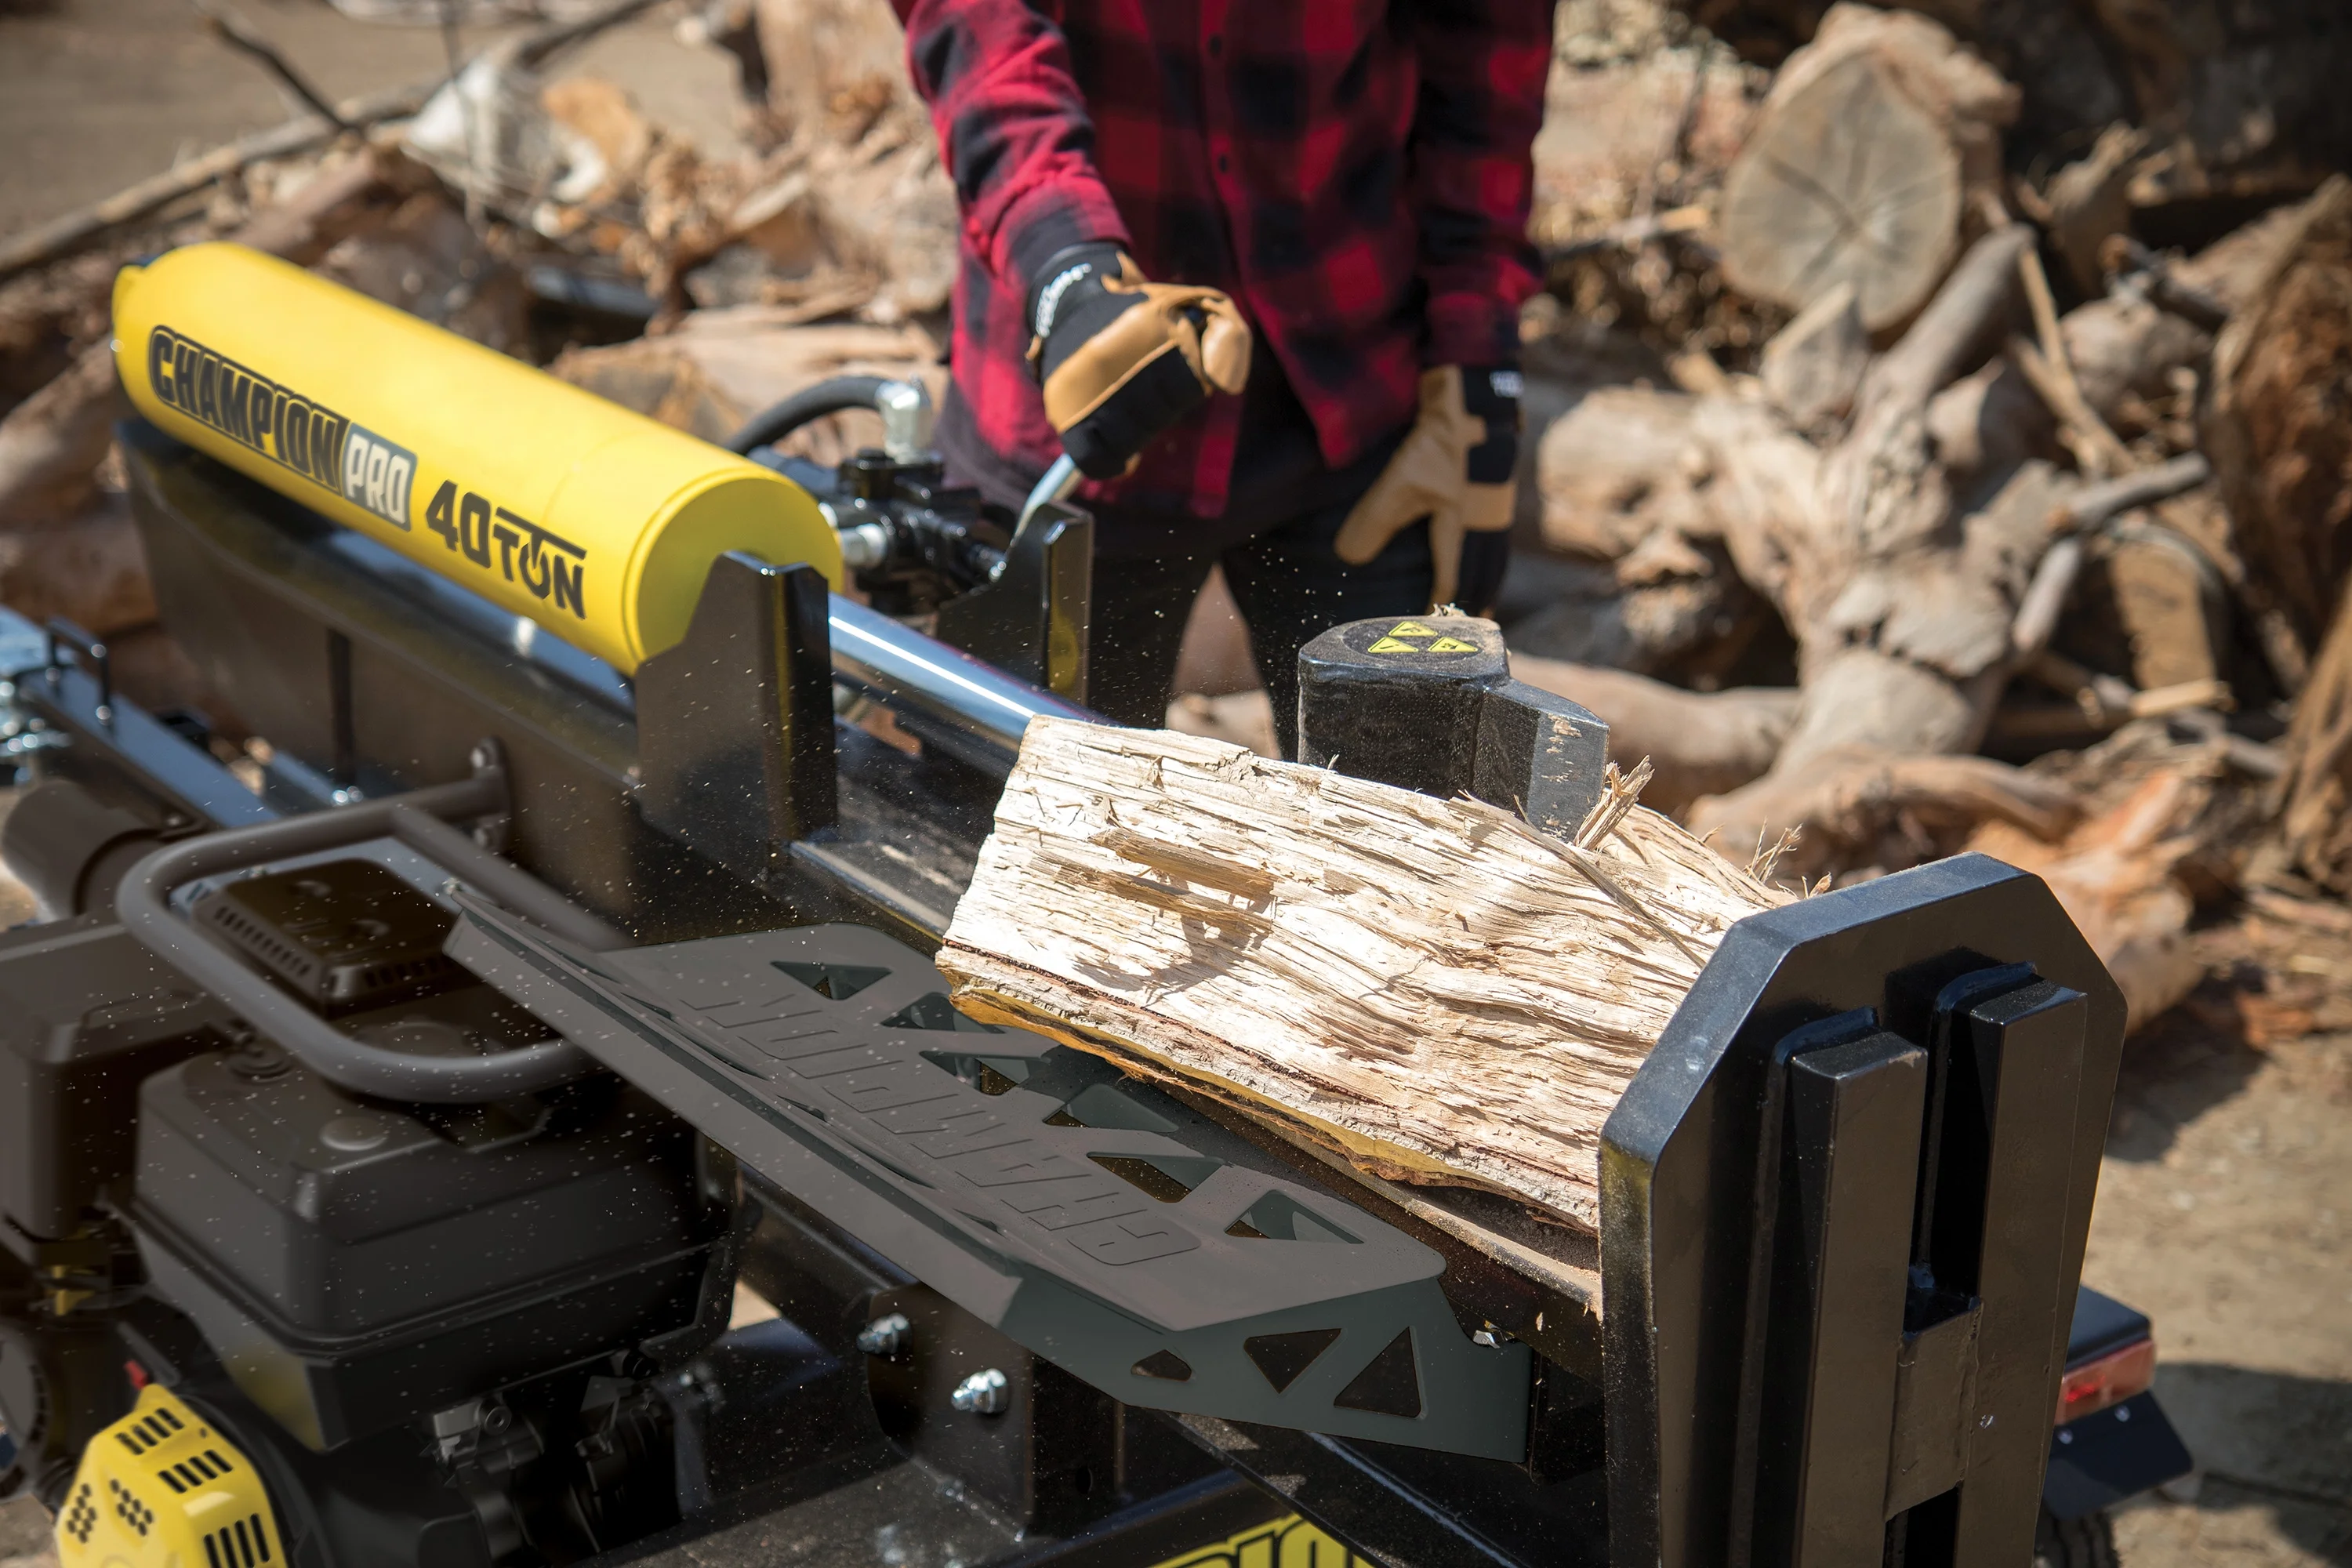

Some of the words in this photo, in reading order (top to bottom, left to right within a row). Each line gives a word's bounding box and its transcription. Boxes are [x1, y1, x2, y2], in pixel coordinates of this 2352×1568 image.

[147, 325, 351, 498] CHAMPION
[345, 431, 412, 525] PRO
[425, 479, 492, 569] 40
